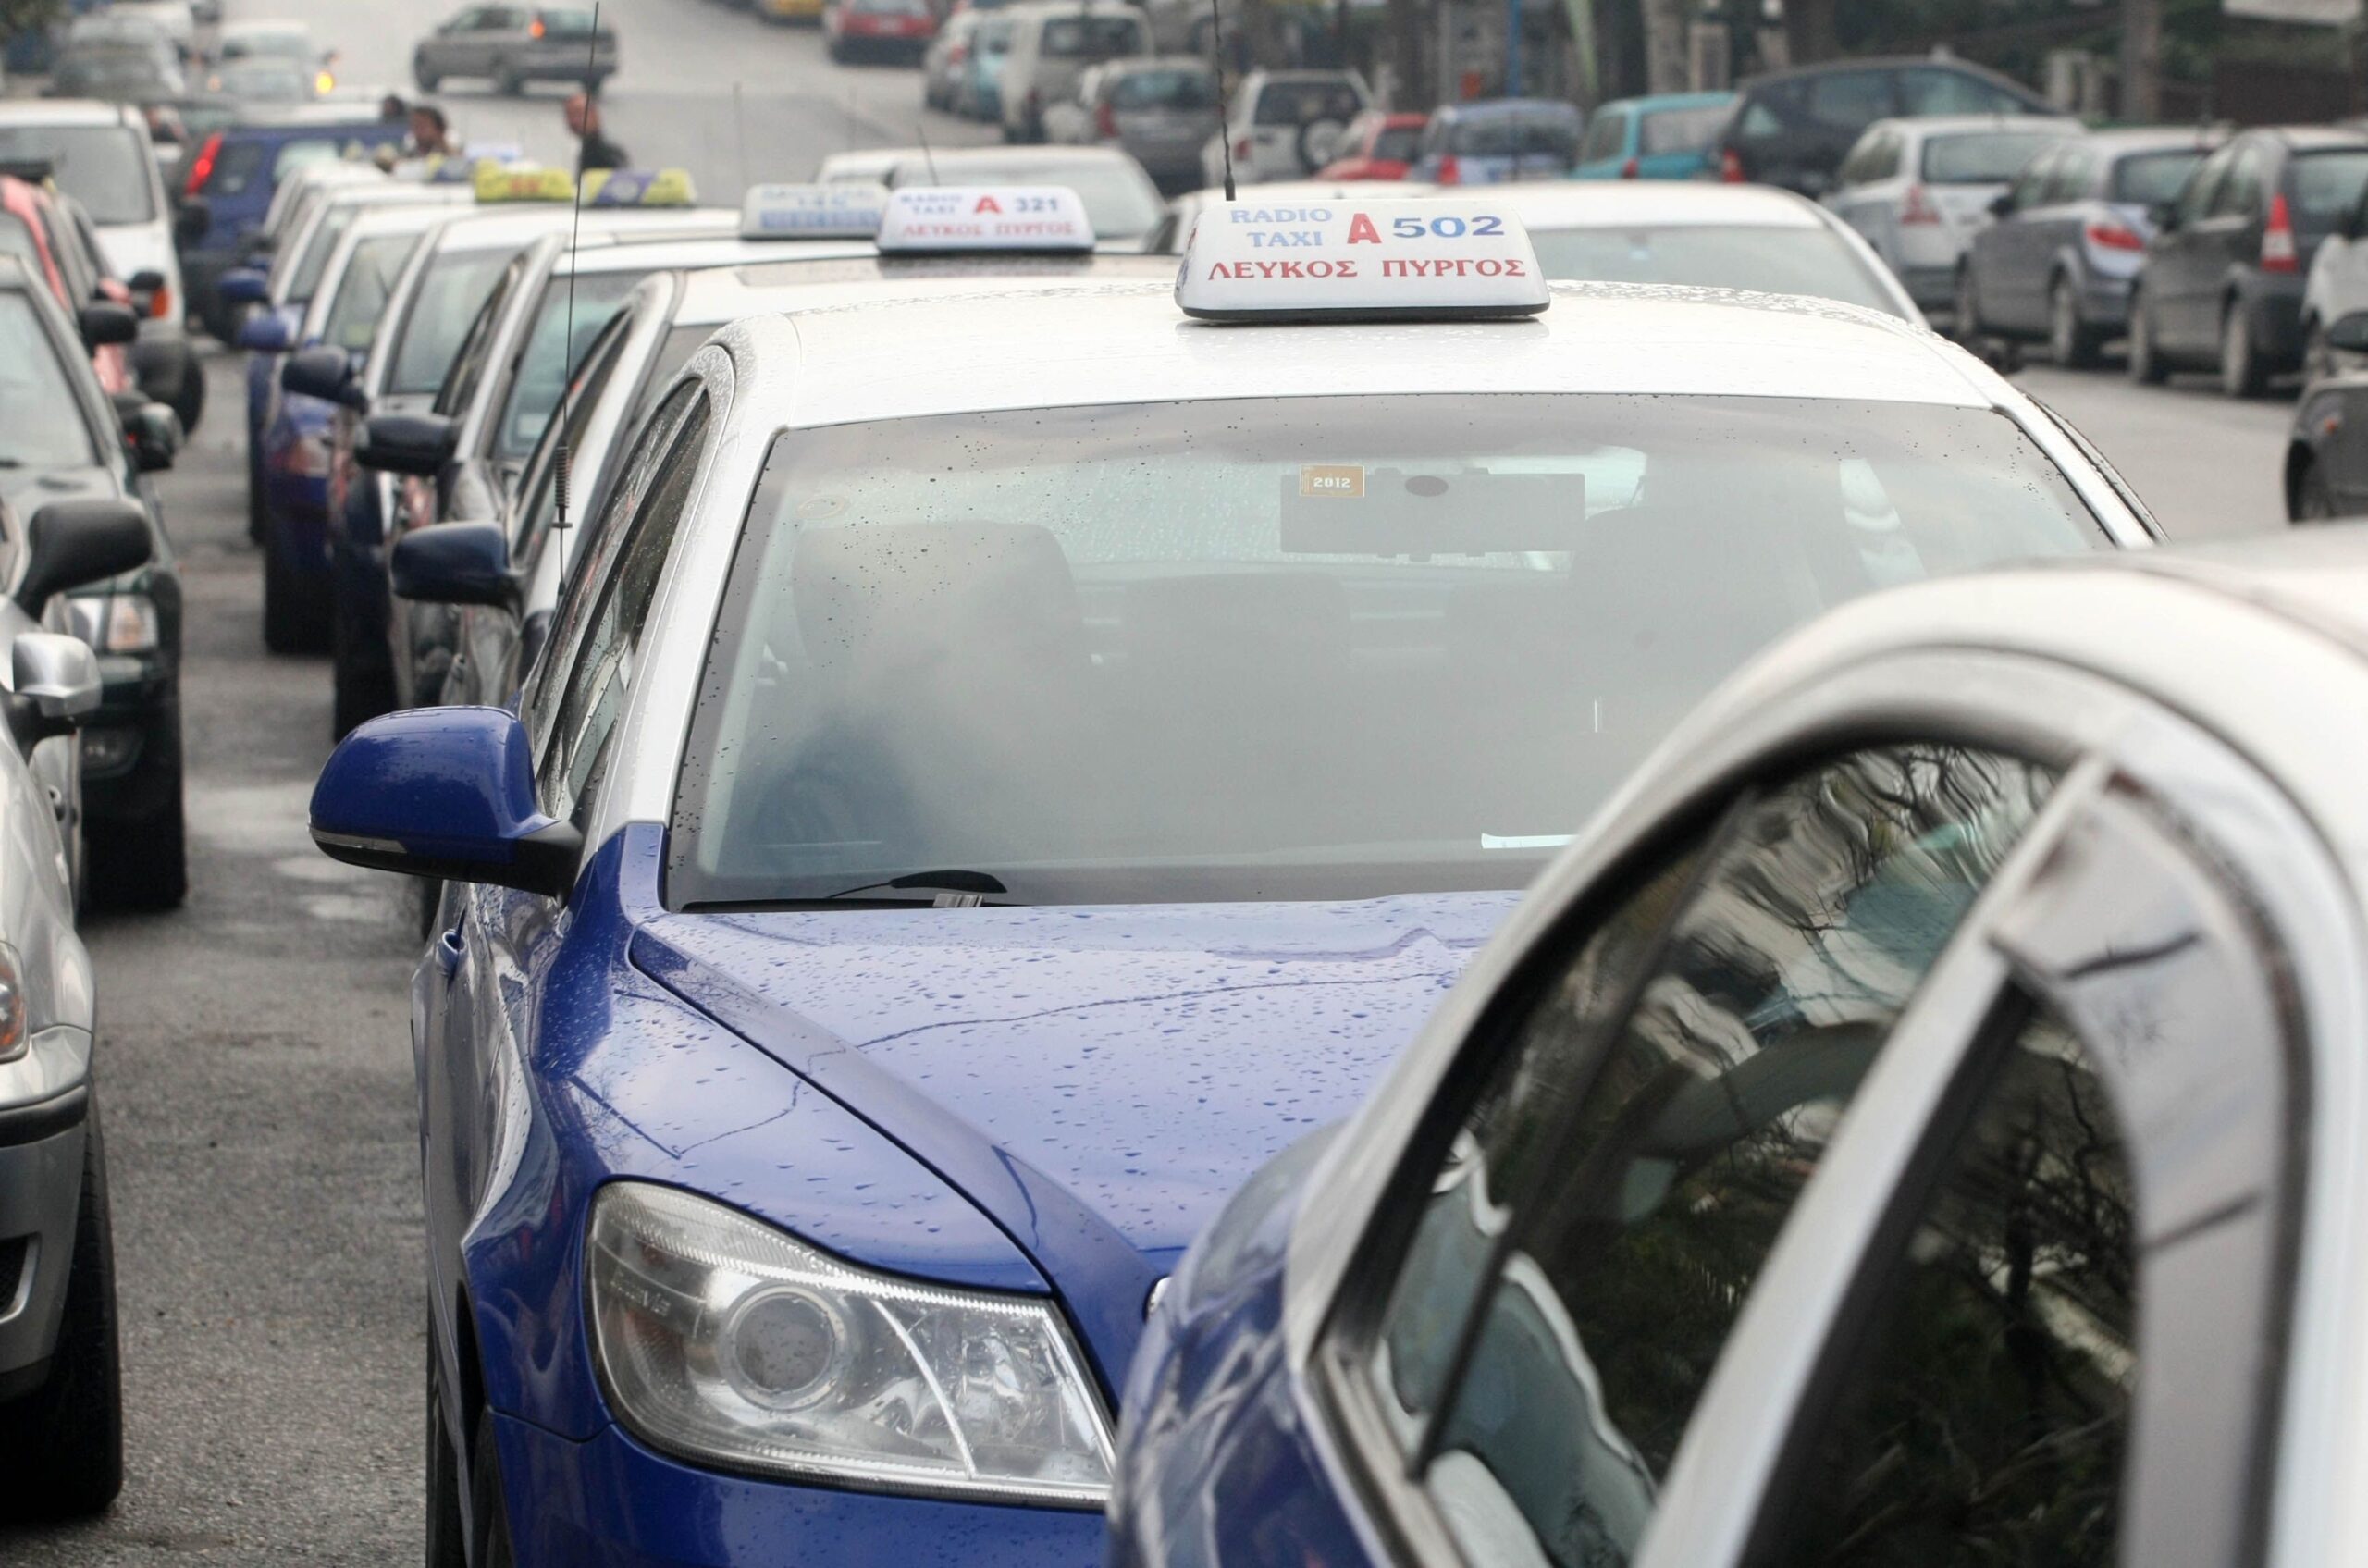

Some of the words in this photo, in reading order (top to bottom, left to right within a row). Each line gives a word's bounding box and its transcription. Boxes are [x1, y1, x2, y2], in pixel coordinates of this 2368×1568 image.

[974, 194, 1002, 215] A
[1016, 197, 1059, 213] 321
[1230, 207, 1333, 224] RADIO
[1347, 212, 1383, 245] A
[1392, 216, 1505, 239] 502
[1246, 230, 1323, 248] TAXI
[1207, 260, 1358, 281] ΛΕΥΚΟΣ
[1382, 258, 1527, 278] ΠΥΡΓΟΣ
[1313, 476, 1351, 488] 2012
